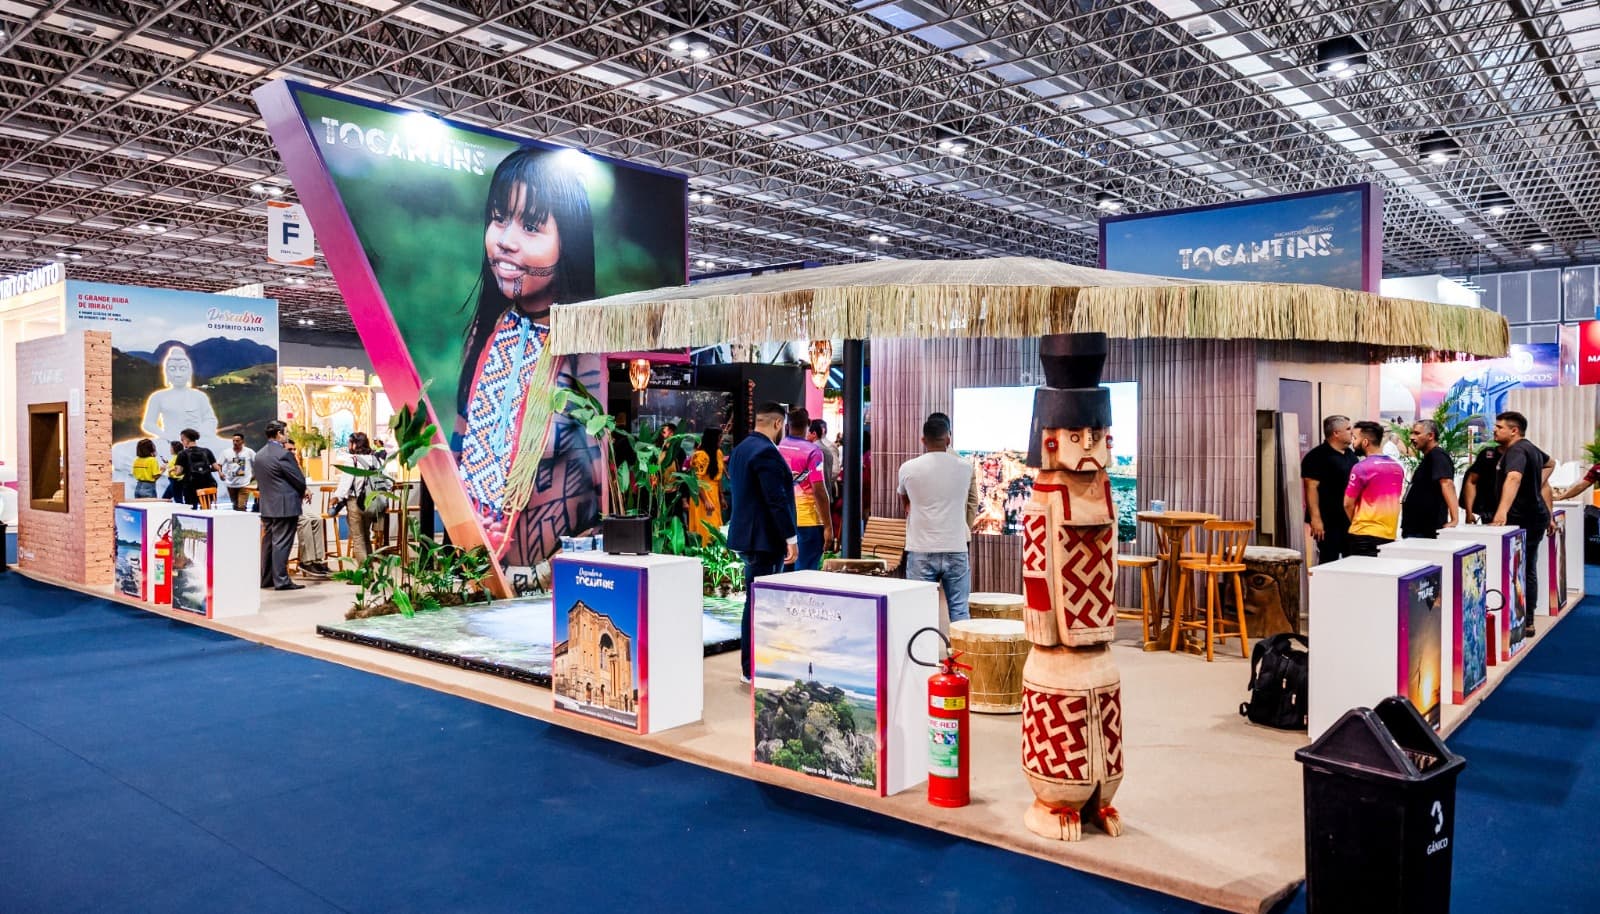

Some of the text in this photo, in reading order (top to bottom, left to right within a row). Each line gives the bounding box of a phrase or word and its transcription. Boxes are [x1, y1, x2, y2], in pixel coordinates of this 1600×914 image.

[282, 222, 300, 244] F
[1178, 233, 1335, 270] TOCANTINS
[25, 263, 58, 292] SANTO
[208, 308, 263, 324] Descubra
